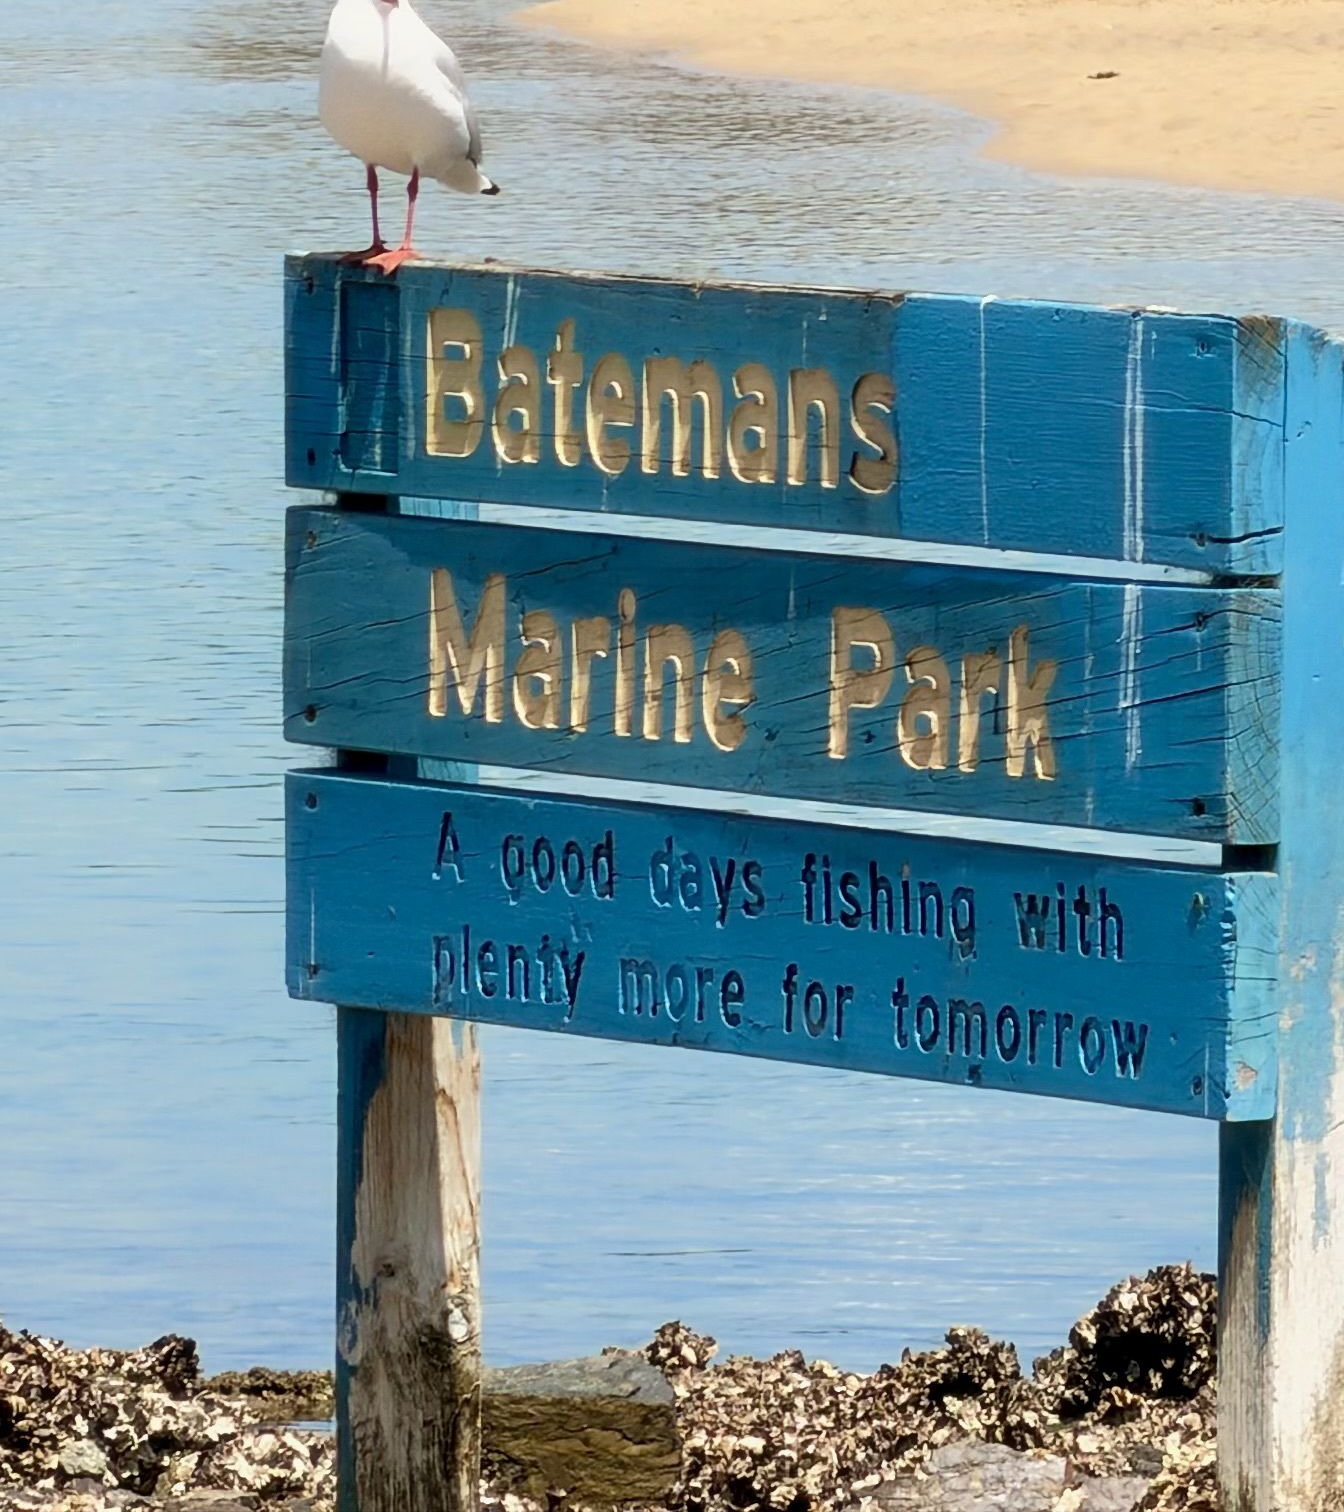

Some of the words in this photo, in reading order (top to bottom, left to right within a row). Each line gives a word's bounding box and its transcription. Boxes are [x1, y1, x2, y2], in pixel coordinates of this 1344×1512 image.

[425, 308, 899, 494] Batemans
[427, 567, 757, 753] Marine
[828, 606, 1058, 782] Park
[431, 811, 465, 882] A
[501, 829, 616, 906] good
[649, 836, 766, 928] days
[801, 853, 976, 961] fishing
[1013, 881, 1124, 962] with
[431, 924, 586, 1023] plenty
[618, 960, 746, 1028] more
[782, 962, 854, 1041] for
[891, 977, 1151, 1080] tomorrow
